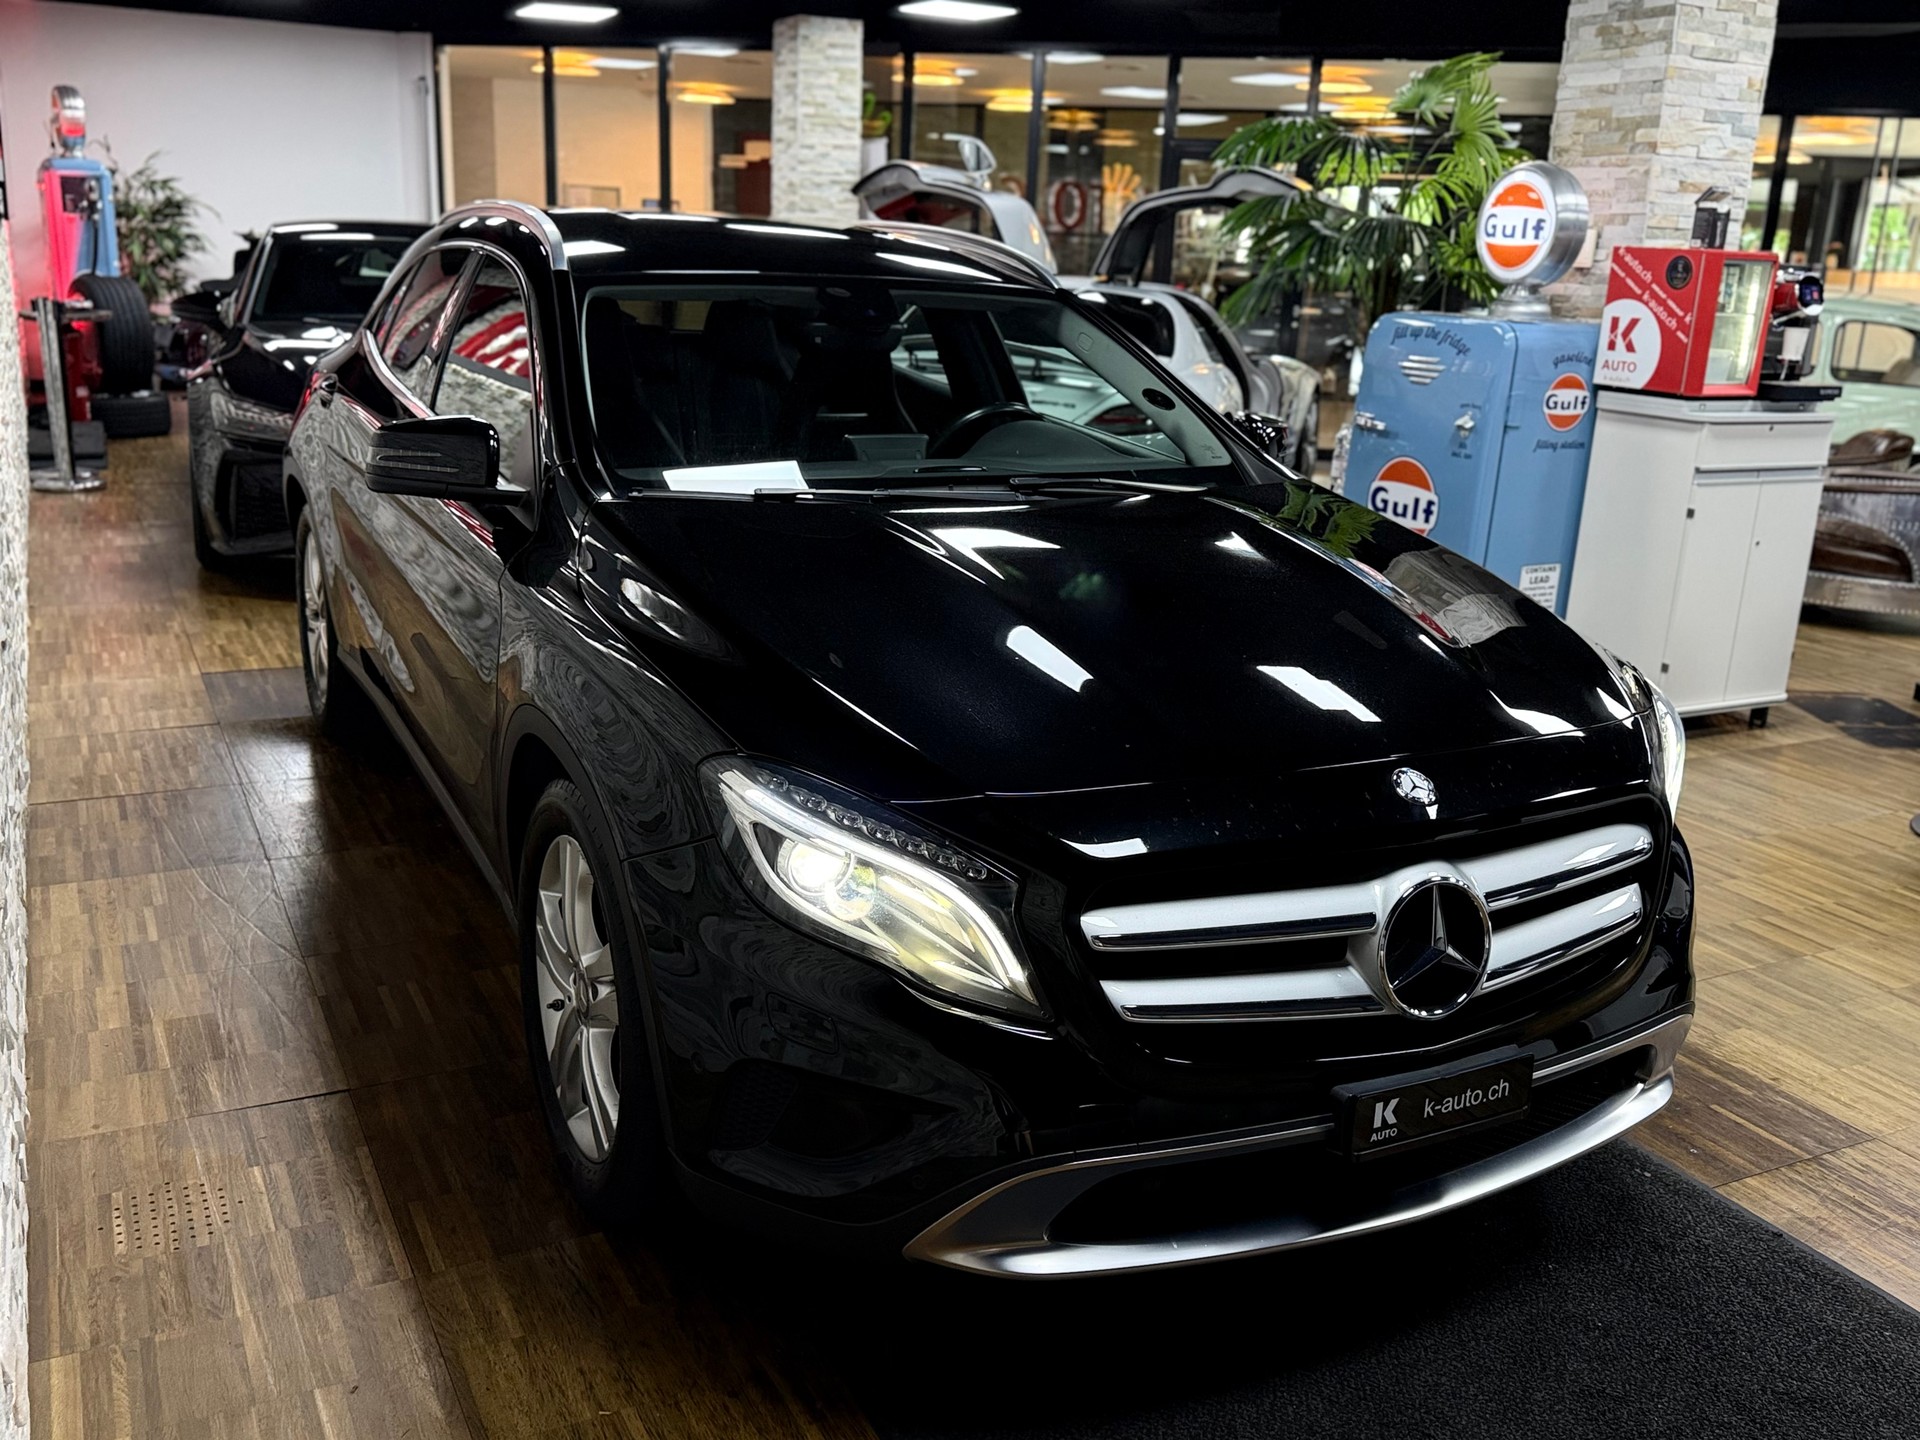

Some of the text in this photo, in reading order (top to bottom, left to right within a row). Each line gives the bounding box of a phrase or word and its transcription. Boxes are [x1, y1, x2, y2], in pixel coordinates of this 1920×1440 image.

[1484, 213, 1546, 240] Gulf
[1618, 247, 1653, 284] k-auto.ch
[1642, 290, 1679, 330] k-auto.ch
[1436, 329, 1472, 356] fridge
[1607, 316, 1642, 354] K
[1552, 351, 1593, 370] gasoline
[1601, 359, 1638, 374] AUTO
[1545, 393, 1588, 411] Gulf
[1371, 486, 1436, 524] Gulf
[1525, 565, 1557, 575] CONTAINS
[1529, 575, 1550, 585] LEAD
[1423, 1079, 1510, 1119] k-auto.ch
[1373, 1097, 1400, 1129] K
[1370, 1127, 1398, 1143] AUTO
